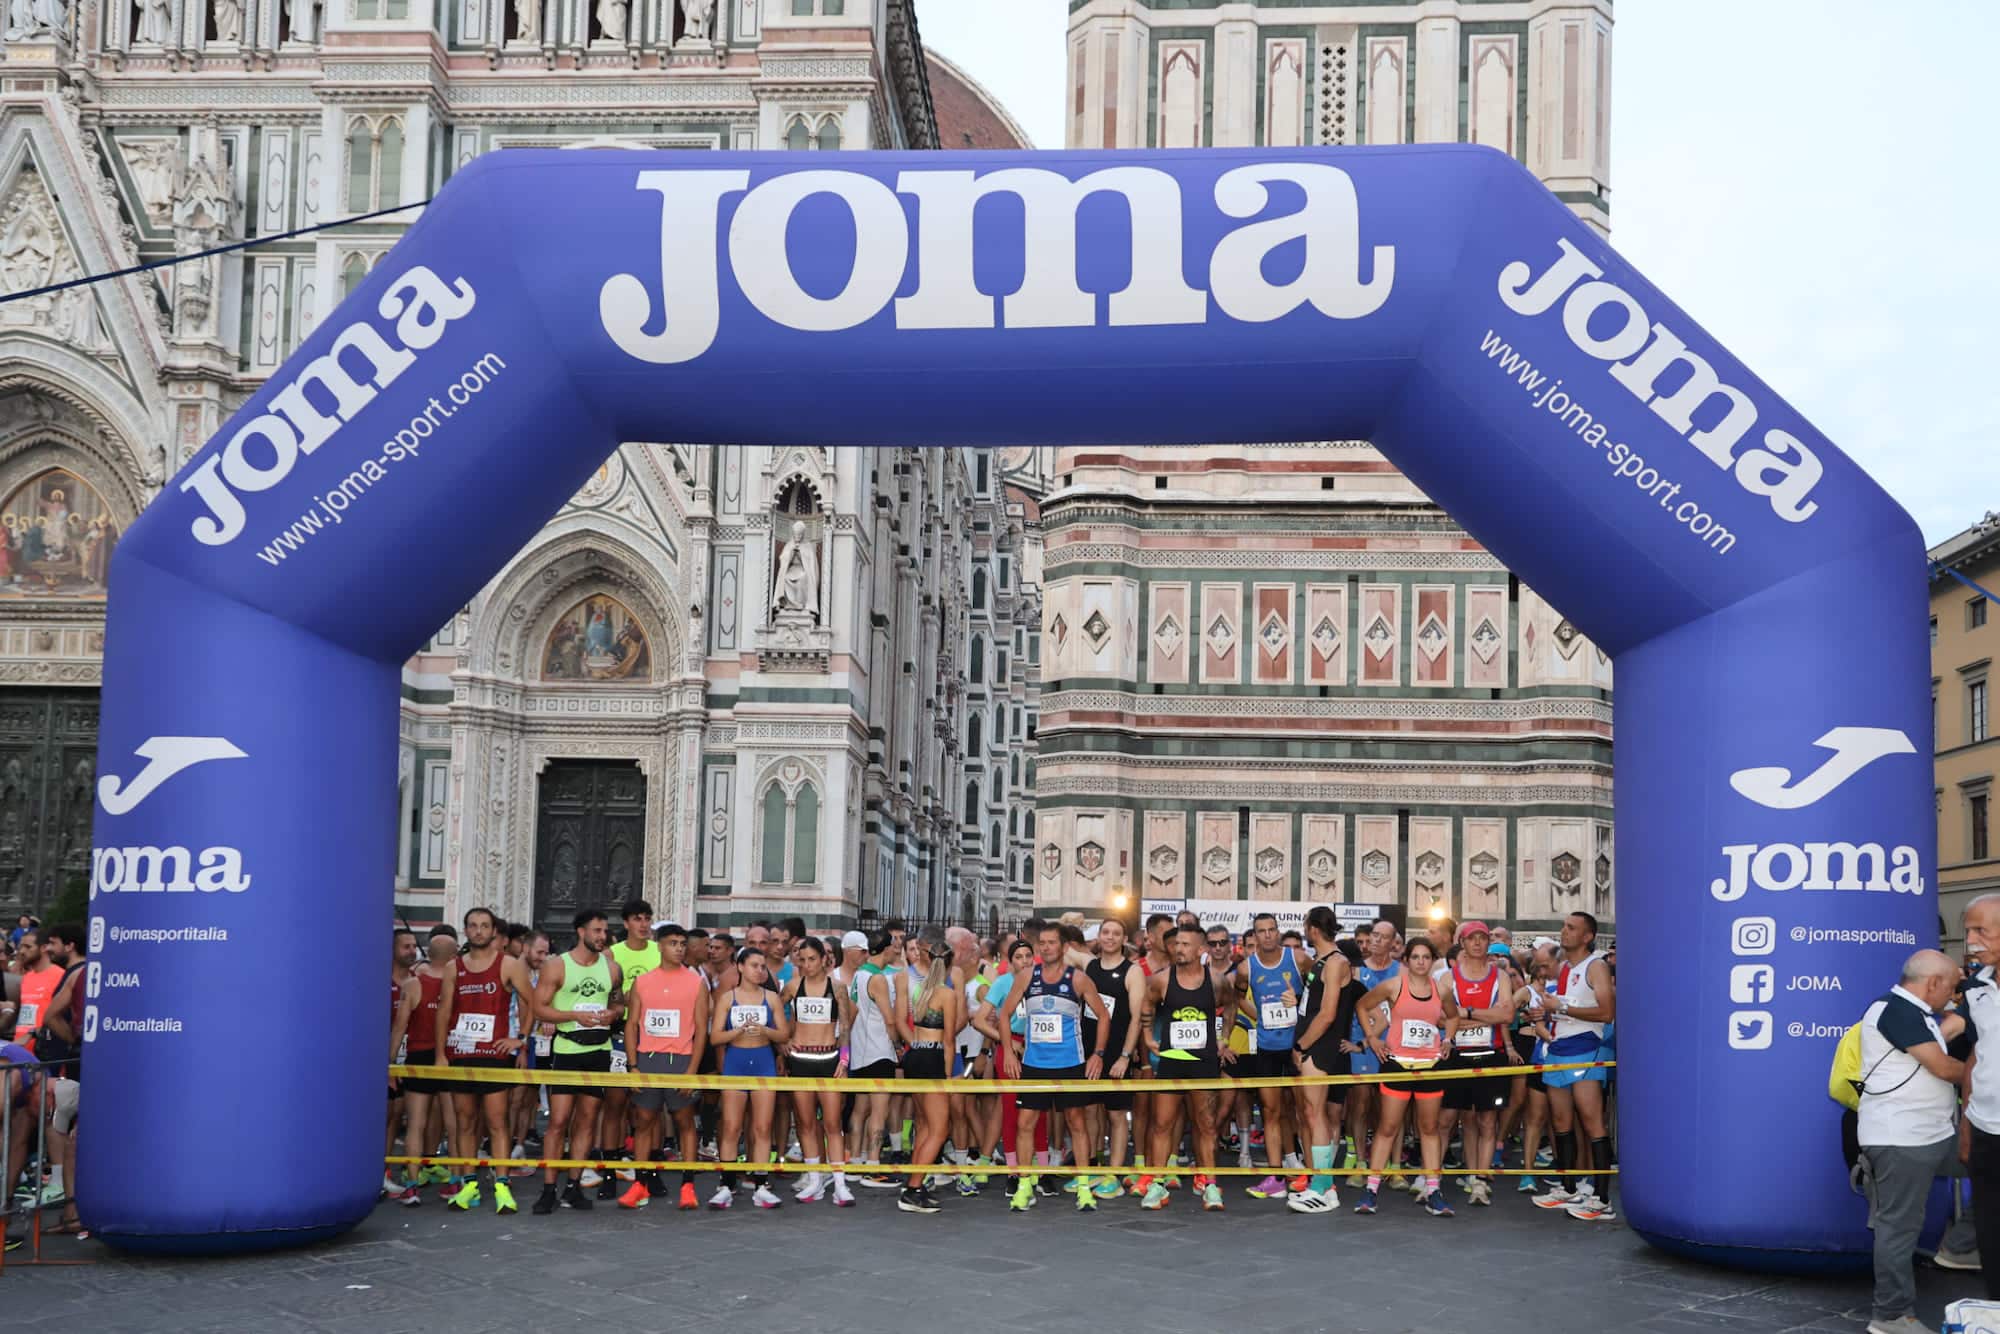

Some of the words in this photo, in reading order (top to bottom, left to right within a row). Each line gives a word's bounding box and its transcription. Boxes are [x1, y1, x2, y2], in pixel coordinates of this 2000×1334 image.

[600, 162, 1395, 363] Joma
[1498, 237, 1823, 523] Joma
[180, 265, 476, 545] Joma
[1480, 329, 1737, 554] www.joma-sport.com
[257, 352, 507, 567] www.joma-sport.com
[1710, 842, 1925, 902] Joma
[110, 926, 228, 944] @jomasportitalia
[1790, 926, 1916, 945] @jomasportitalia
[105, 973, 140, 987] JOMA
[1786, 975, 1842, 991] JOMA
[803, 1004, 824, 1014] 302
[1269, 1008, 1289, 1019] 141
[103, 1017, 183, 1033] @JomaItalia
[465, 1021, 486, 1032] 102
[651, 1017, 671, 1027] 301
[1034, 1022, 1055, 1032] 708
[1177, 1028, 1200, 1039] 300
[1409, 1027, 1432, 1038] 932
